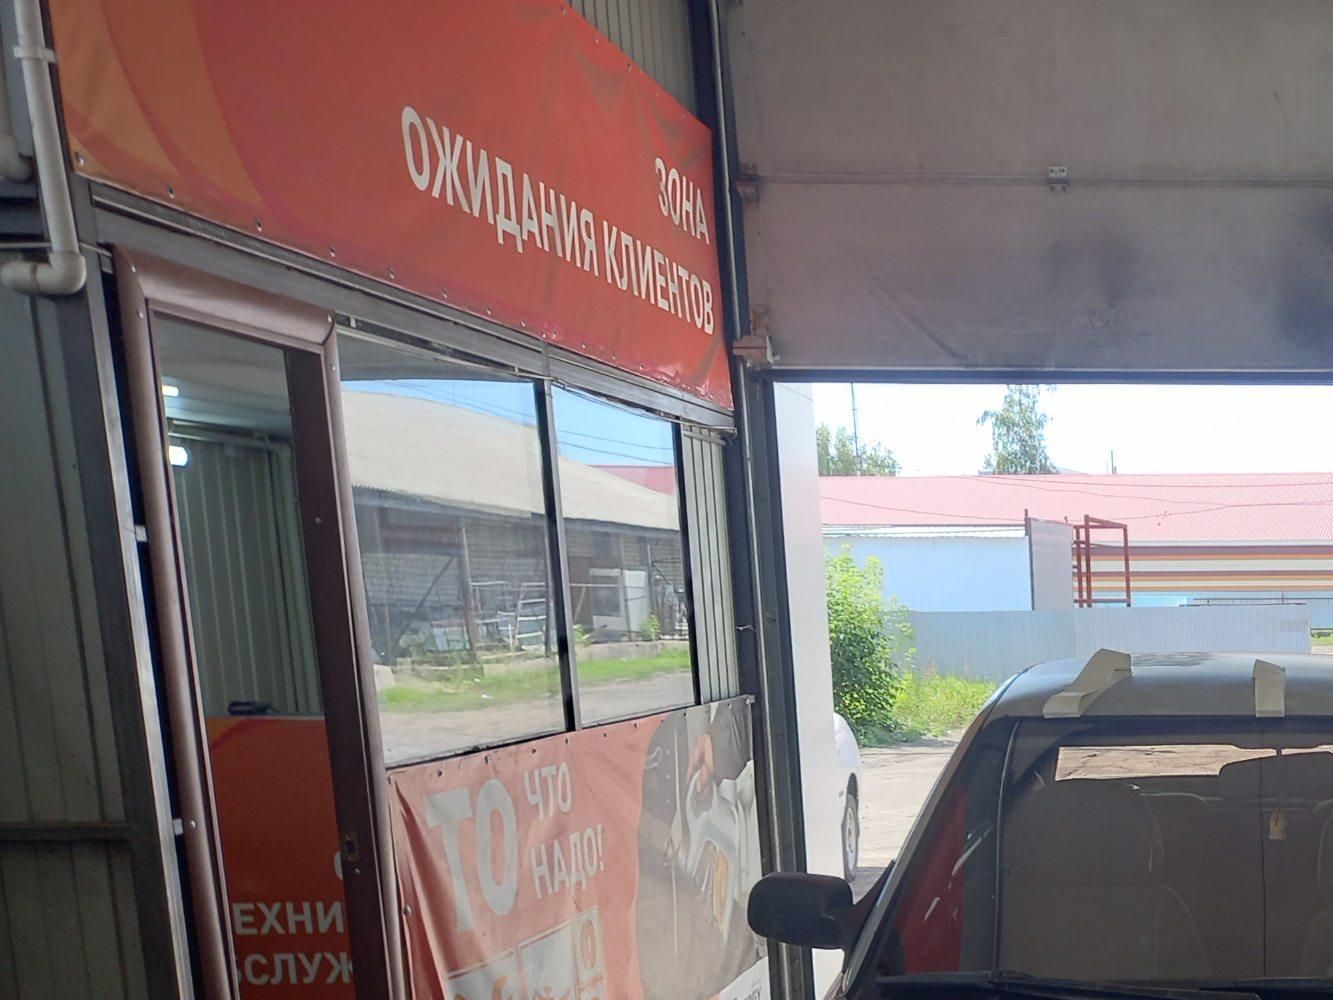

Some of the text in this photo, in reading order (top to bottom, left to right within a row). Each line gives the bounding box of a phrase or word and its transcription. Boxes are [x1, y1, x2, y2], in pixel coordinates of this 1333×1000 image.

[401, 106, 714, 335] ОЖИДАНИЯ КЛИЕНТОВ
[655, 157, 710, 246] ЗОНА
[524, 762, 572, 821] ЧТО
[426, 778, 519, 933] ТО
[530, 824, 604, 898] НАДО!
[236, 951, 353, 985] СЛУЖ
